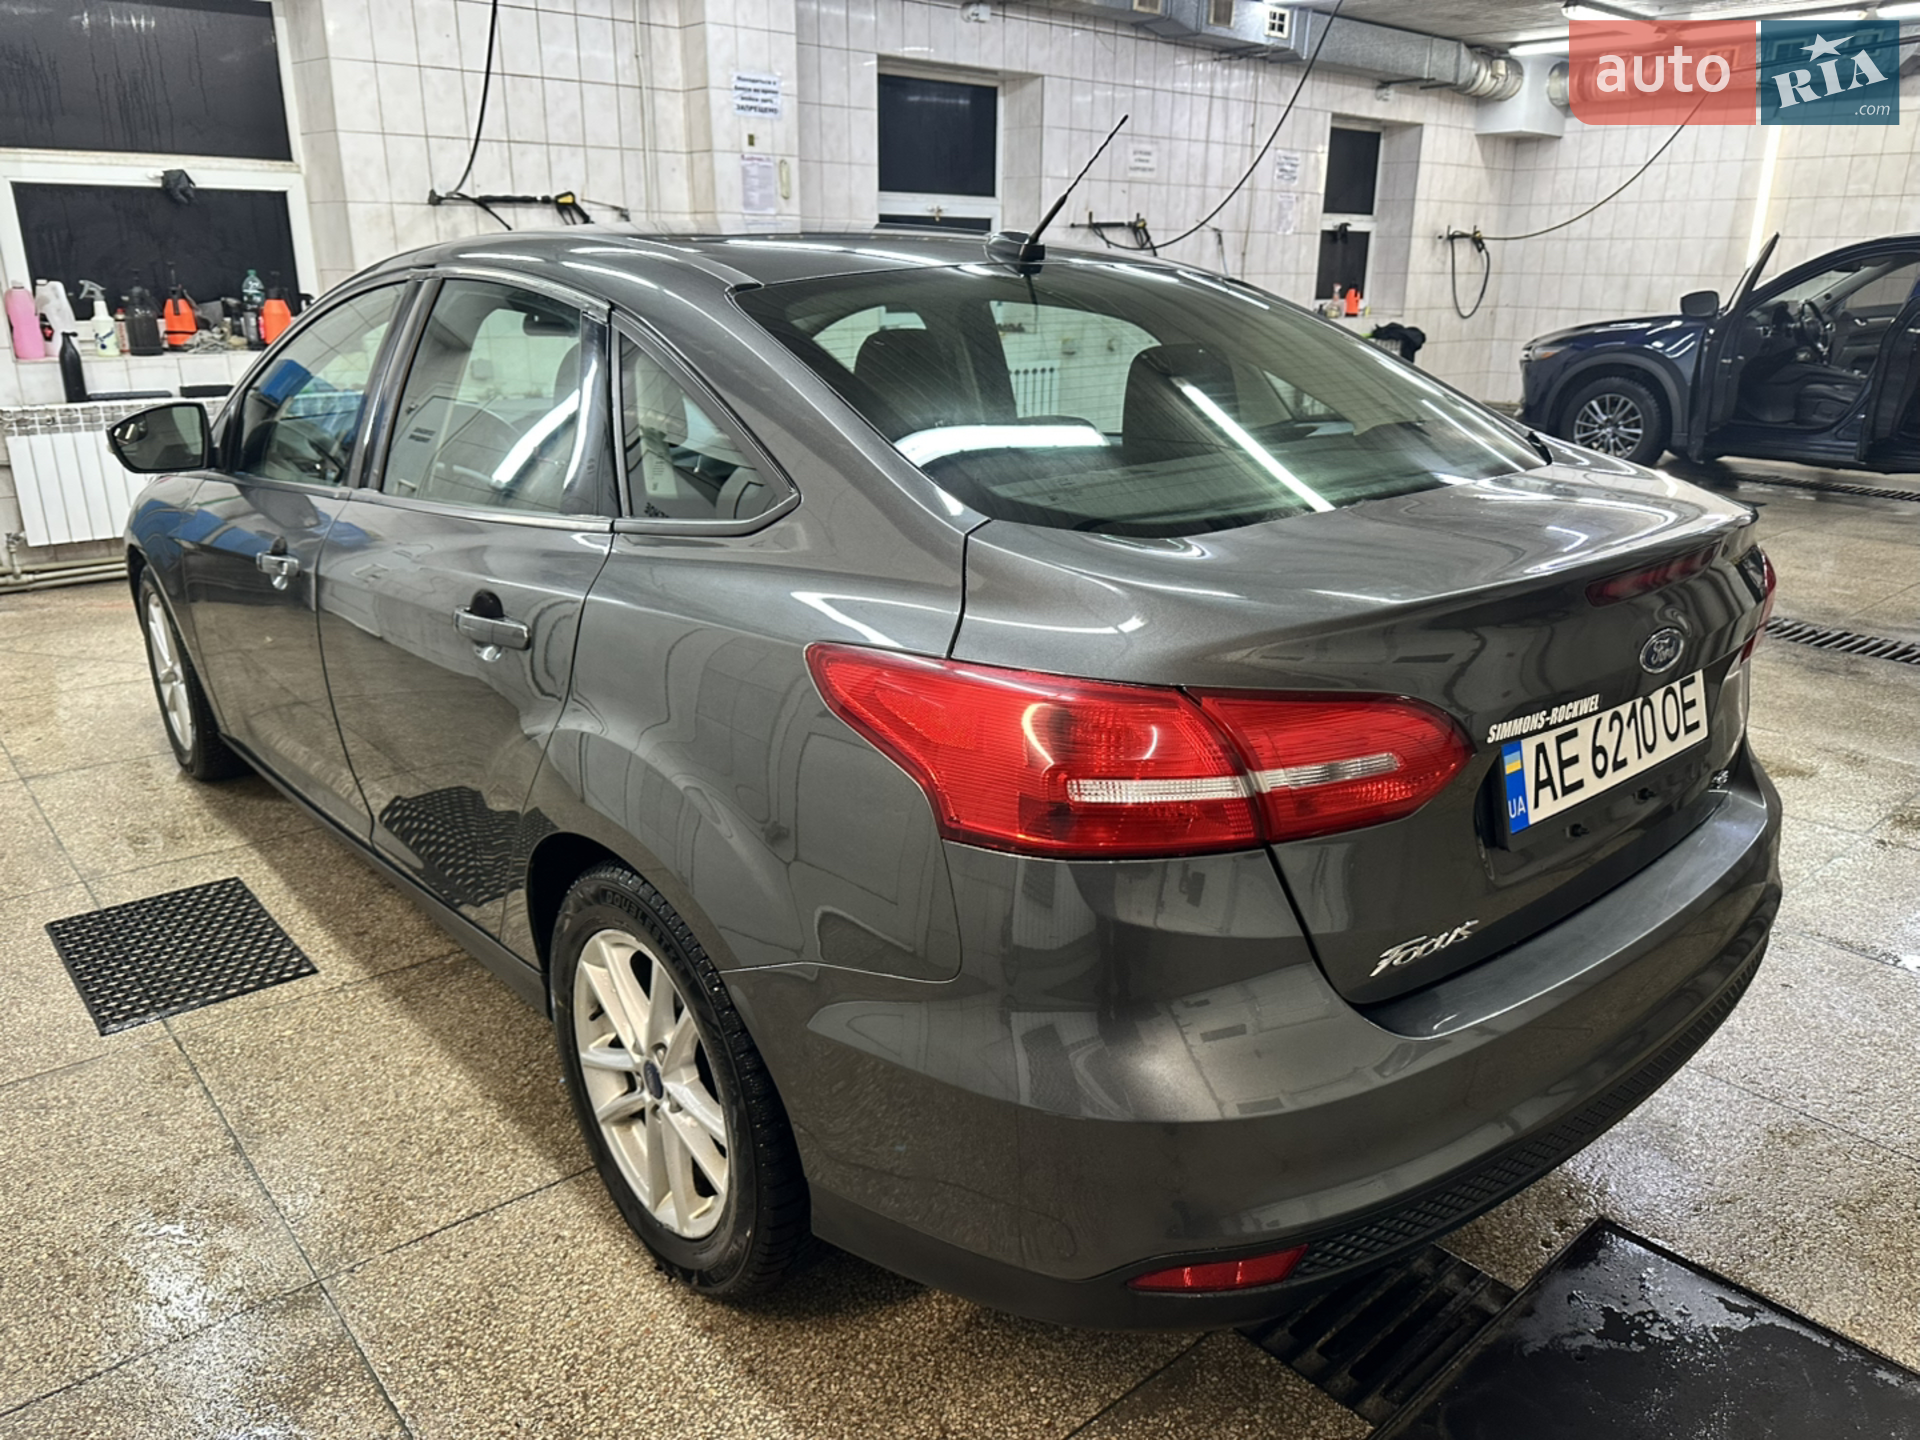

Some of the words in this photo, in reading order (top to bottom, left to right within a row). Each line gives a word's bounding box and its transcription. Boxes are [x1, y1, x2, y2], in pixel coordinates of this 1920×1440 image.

[1651, 637, 1676, 665] Ford
[1487, 693, 1600, 744] SIMMONS-ROCKWEL
[1532, 727, 1585, 810] AE
[1591, 695, 1657, 779] 6210
[1661, 674, 1701, 742] OE
[1508, 795, 1526, 819] UA
[1369, 919, 1480, 977] Focus
